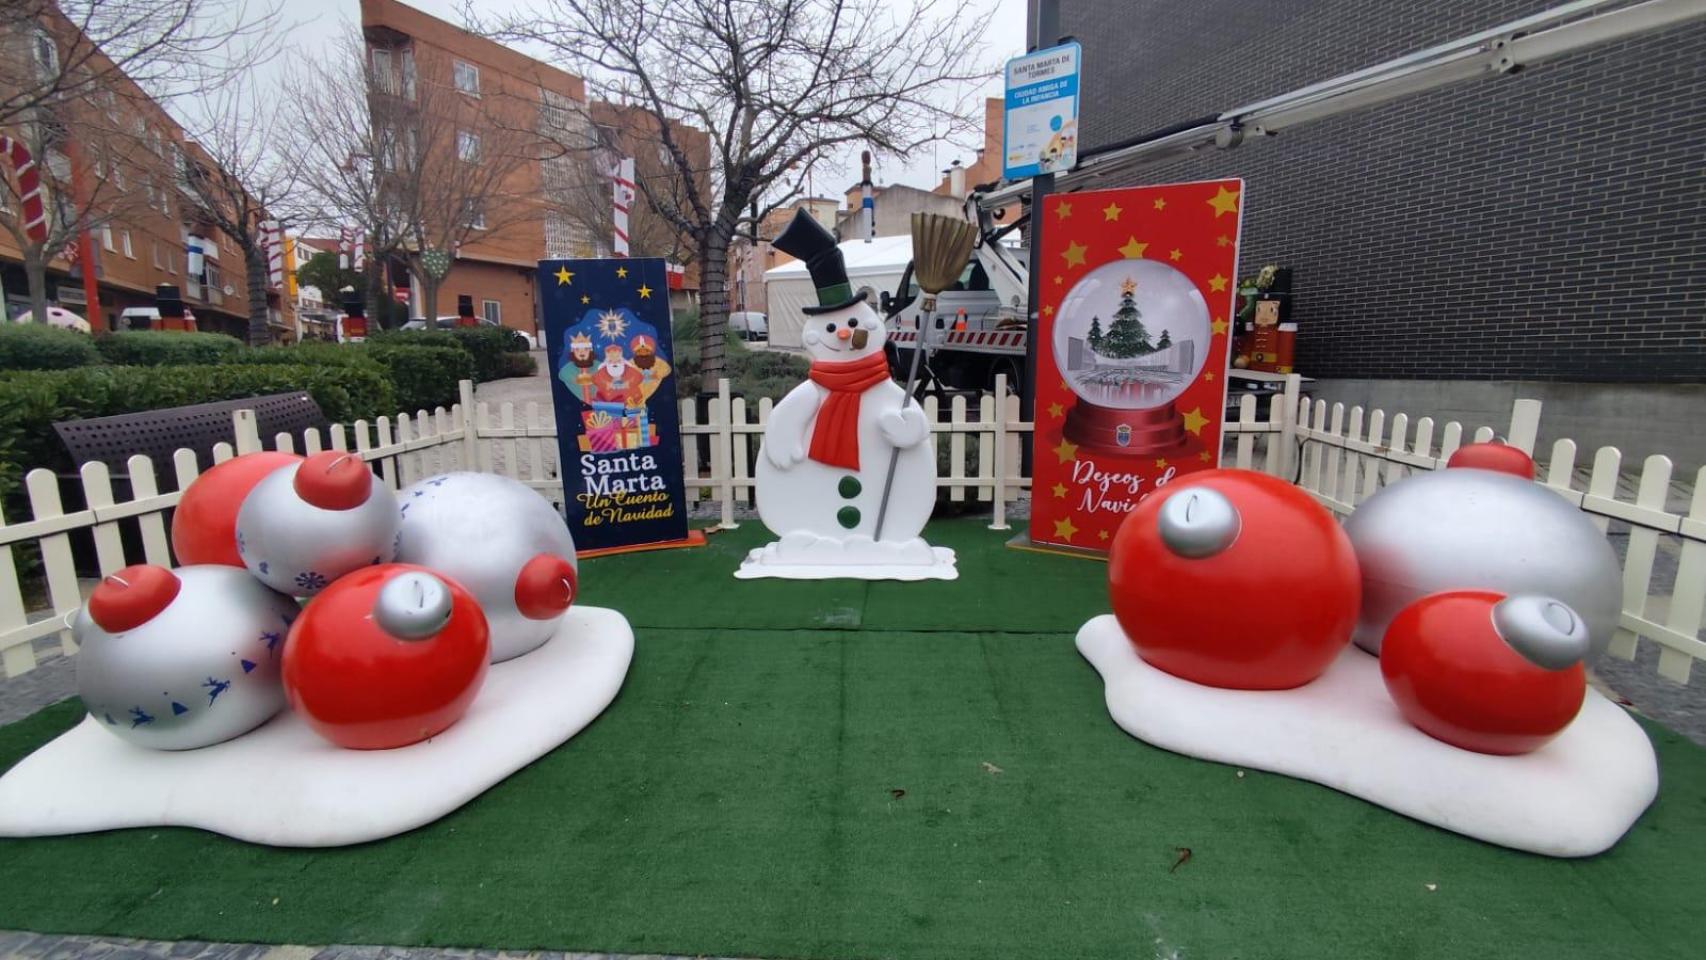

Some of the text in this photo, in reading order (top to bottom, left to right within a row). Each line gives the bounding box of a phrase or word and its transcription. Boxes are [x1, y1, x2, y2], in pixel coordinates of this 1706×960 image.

[1014, 55, 1070, 75] SANTA MARTA DE
[1028, 67, 1055, 78] TORMES
[1014, 88, 1037, 98] CIUDAD
[1060, 80, 1068, 88] DE
[580, 453, 657, 476] Santa
[584, 474, 666, 496] Marta
[1073, 460, 1176, 494] Deseos d
[577, 489, 670, 510] Un Cuento
[584, 503, 674, 527] de Navidad
